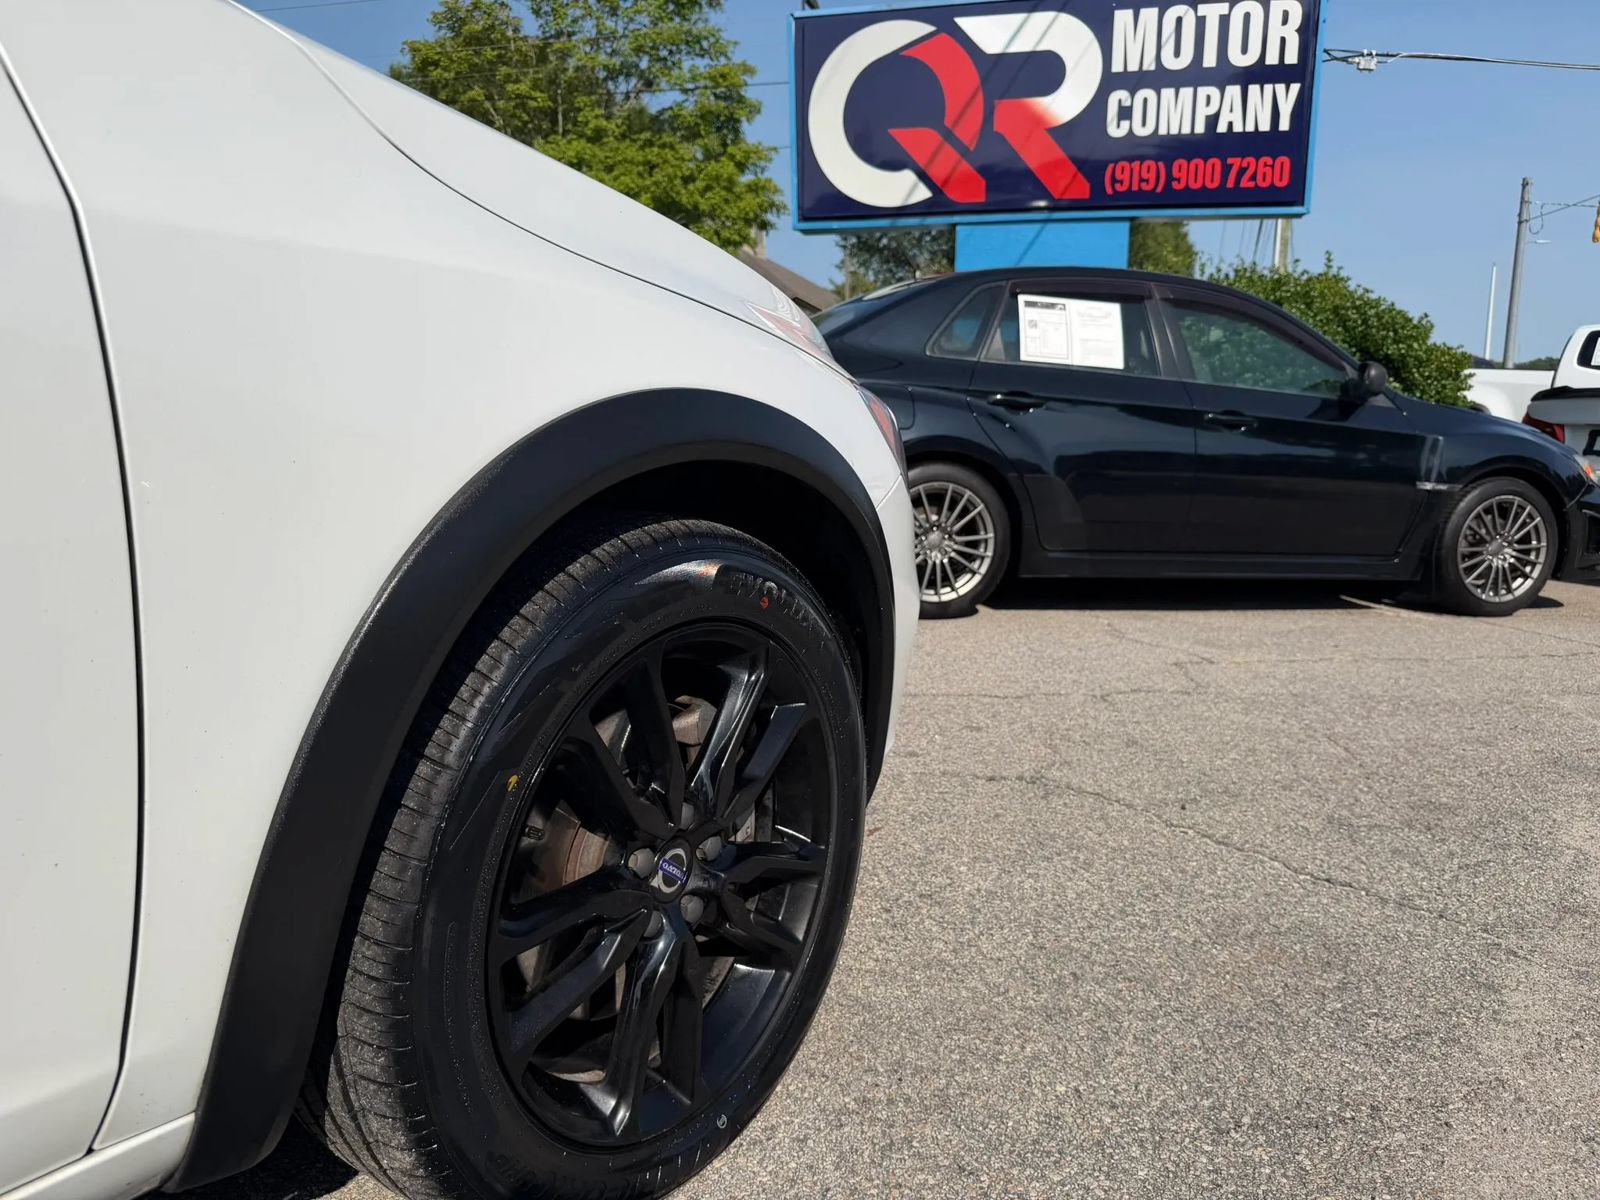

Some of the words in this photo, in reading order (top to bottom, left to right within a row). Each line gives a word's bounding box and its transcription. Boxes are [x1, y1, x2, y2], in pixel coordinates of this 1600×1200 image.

[1111, 0, 1303, 72] MOTOR
[1106, 83, 1301, 138] COMPANY
[1104, 160, 1166, 195] (919)
[1171, 158, 1222, 190] 900
[1226, 156, 1291, 188] 7260
